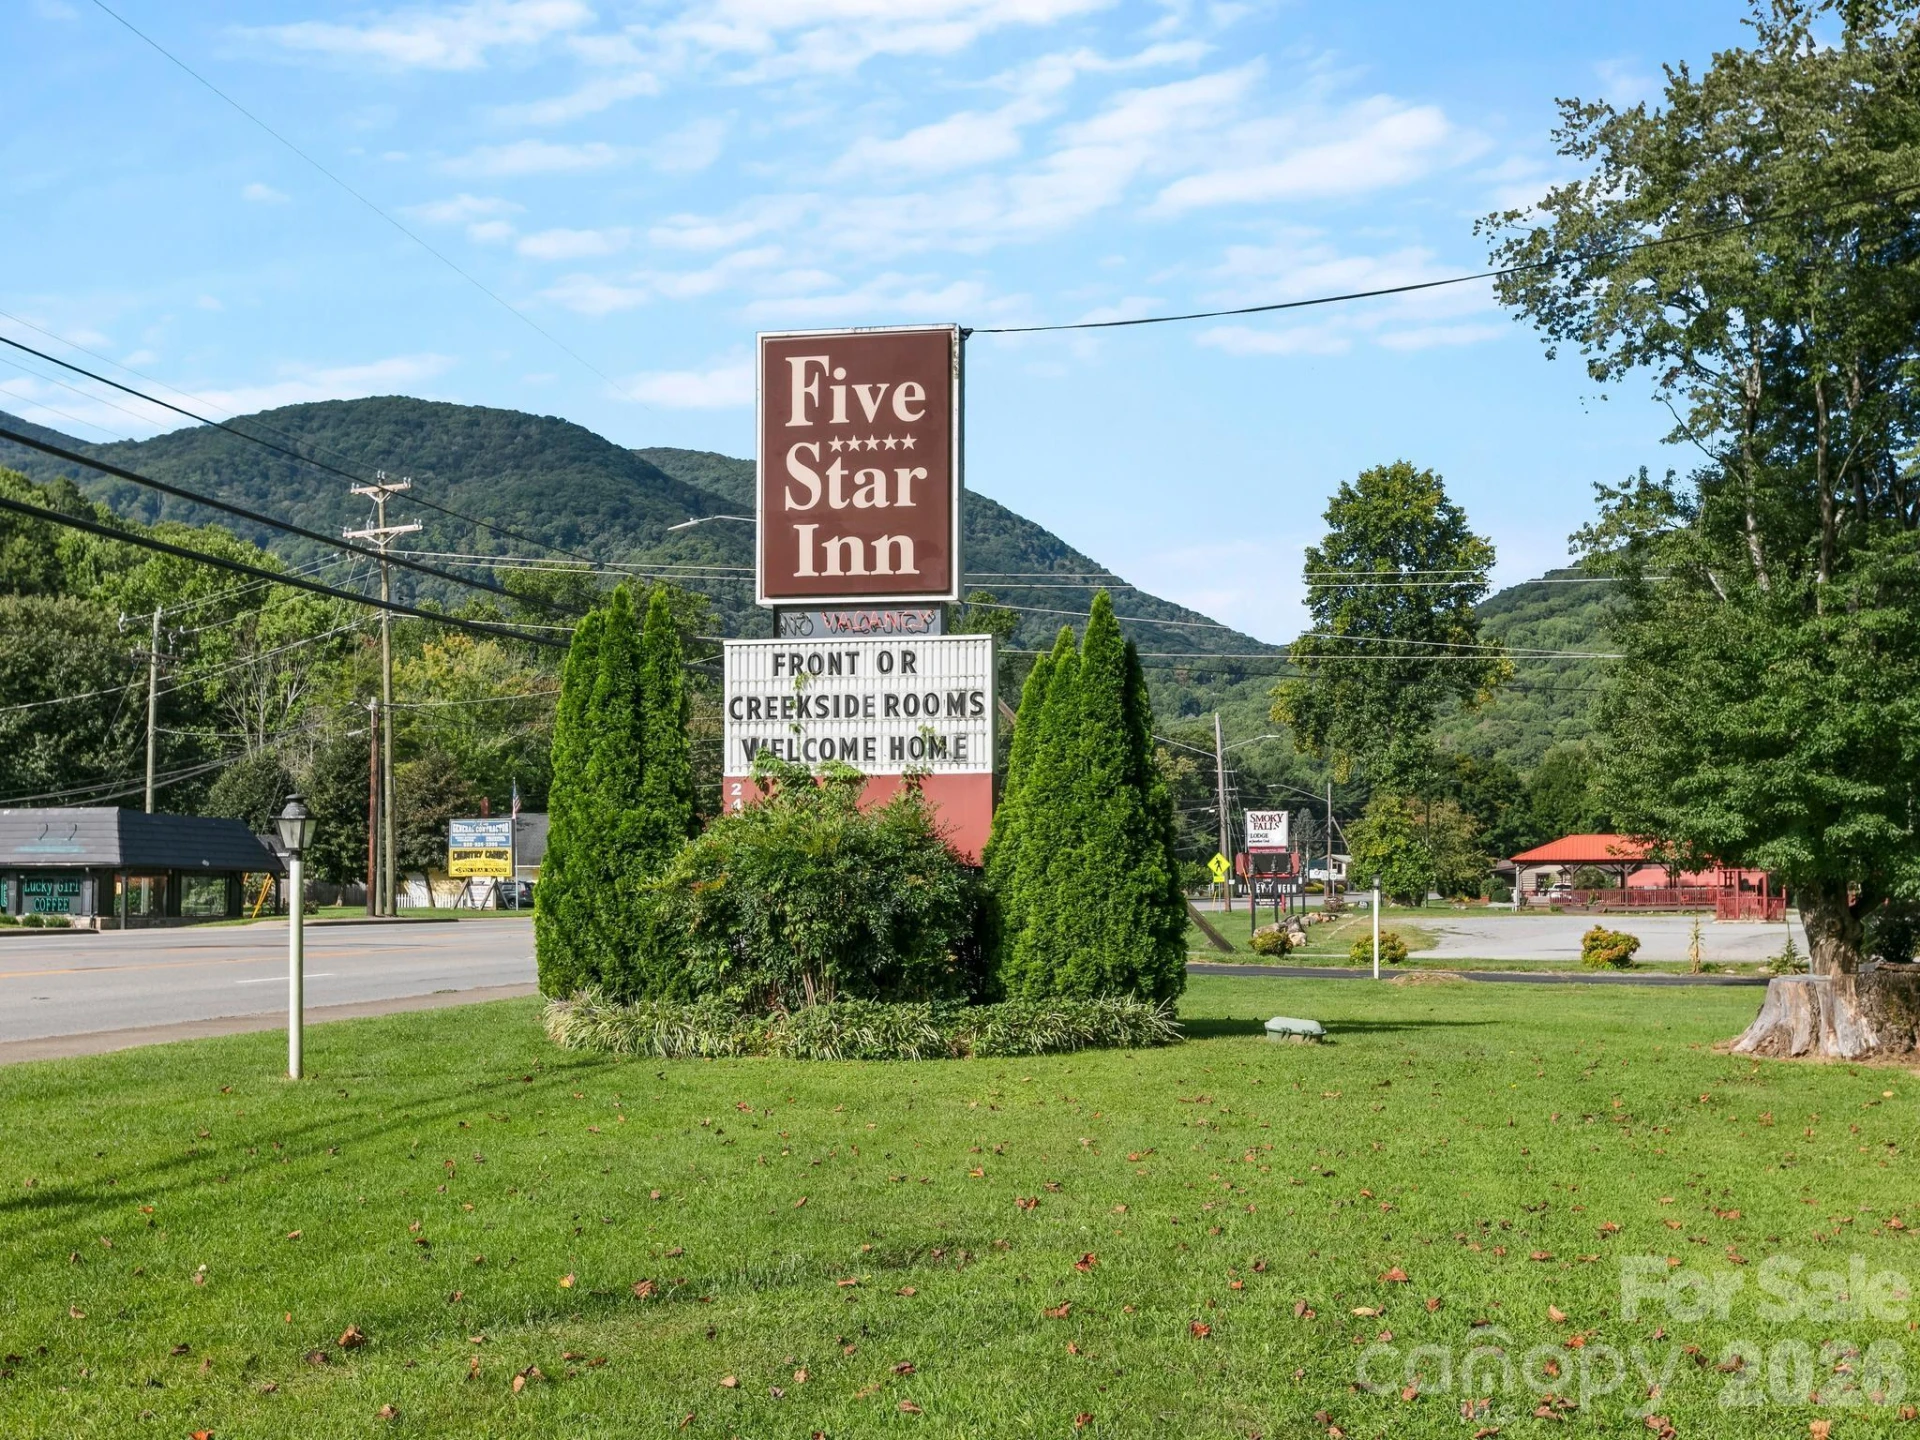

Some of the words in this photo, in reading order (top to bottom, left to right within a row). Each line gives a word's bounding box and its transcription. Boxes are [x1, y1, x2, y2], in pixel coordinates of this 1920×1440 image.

[785, 355, 926, 427] Five
[785, 441, 928, 511] Star
[793, 523, 920, 577] Inn
[780, 612, 814, 636] NO
[821, 610, 935, 634] VACANCY
[773, 651, 859, 676] FRONT
[877, 650, 917, 674] OR
[729, 694, 876, 720] CREEKSIDE
[884, 692, 985, 717] ROOMS
[742, 737, 876, 762] WELCOME
[890, 735, 968, 761] HOME
[1250, 813, 1284, 823] SMOKY
[1253, 822, 1280, 830] FALLS
[24, 878, 53, 896] Lucky
[57, 880, 80, 893] Girl
[1238, 883, 1266, 893] VALEY
[1268, 883, 1297, 893] TVERN
[34, 898, 69, 912] COFFEE
